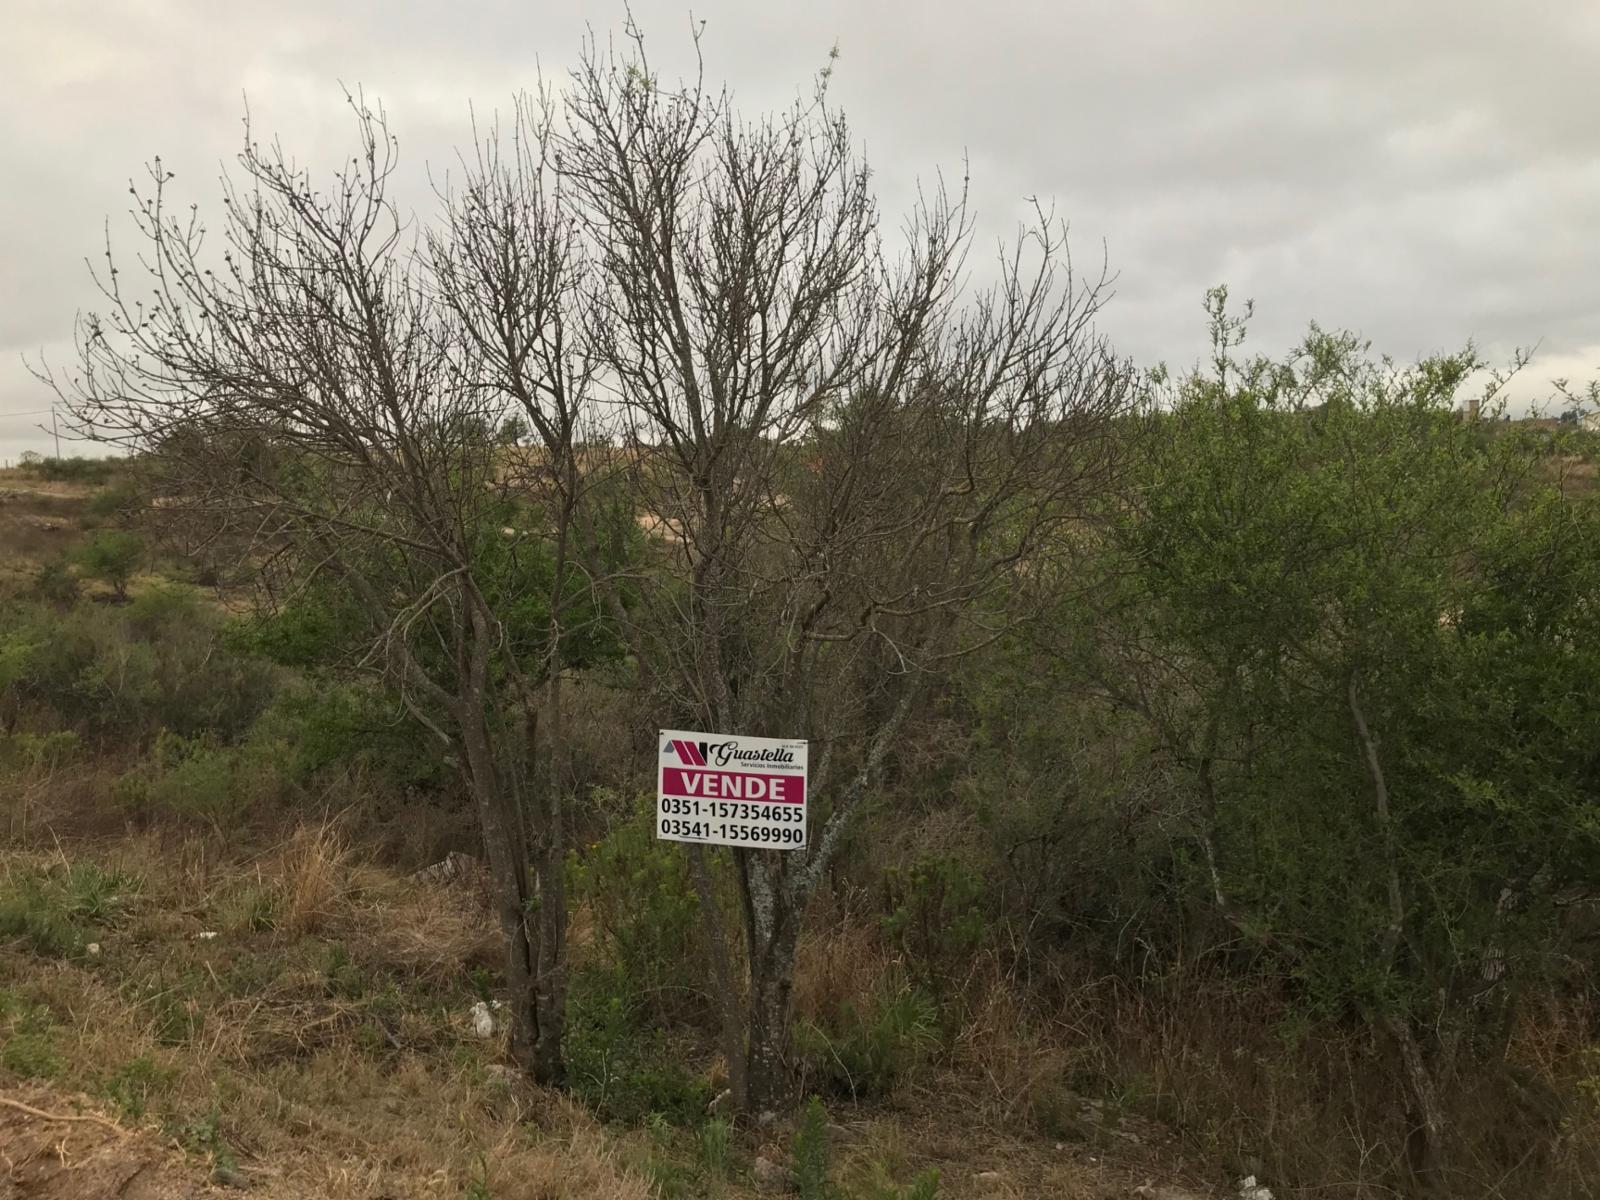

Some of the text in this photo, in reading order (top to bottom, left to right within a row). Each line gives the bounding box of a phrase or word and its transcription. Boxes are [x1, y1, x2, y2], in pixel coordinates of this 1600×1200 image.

[709, 741, 794, 766] Guastella
[681, 772, 785, 800] VENDE
[661, 798, 803, 822] 0351-157354655
[661, 819, 803, 843] 03541-15569990
